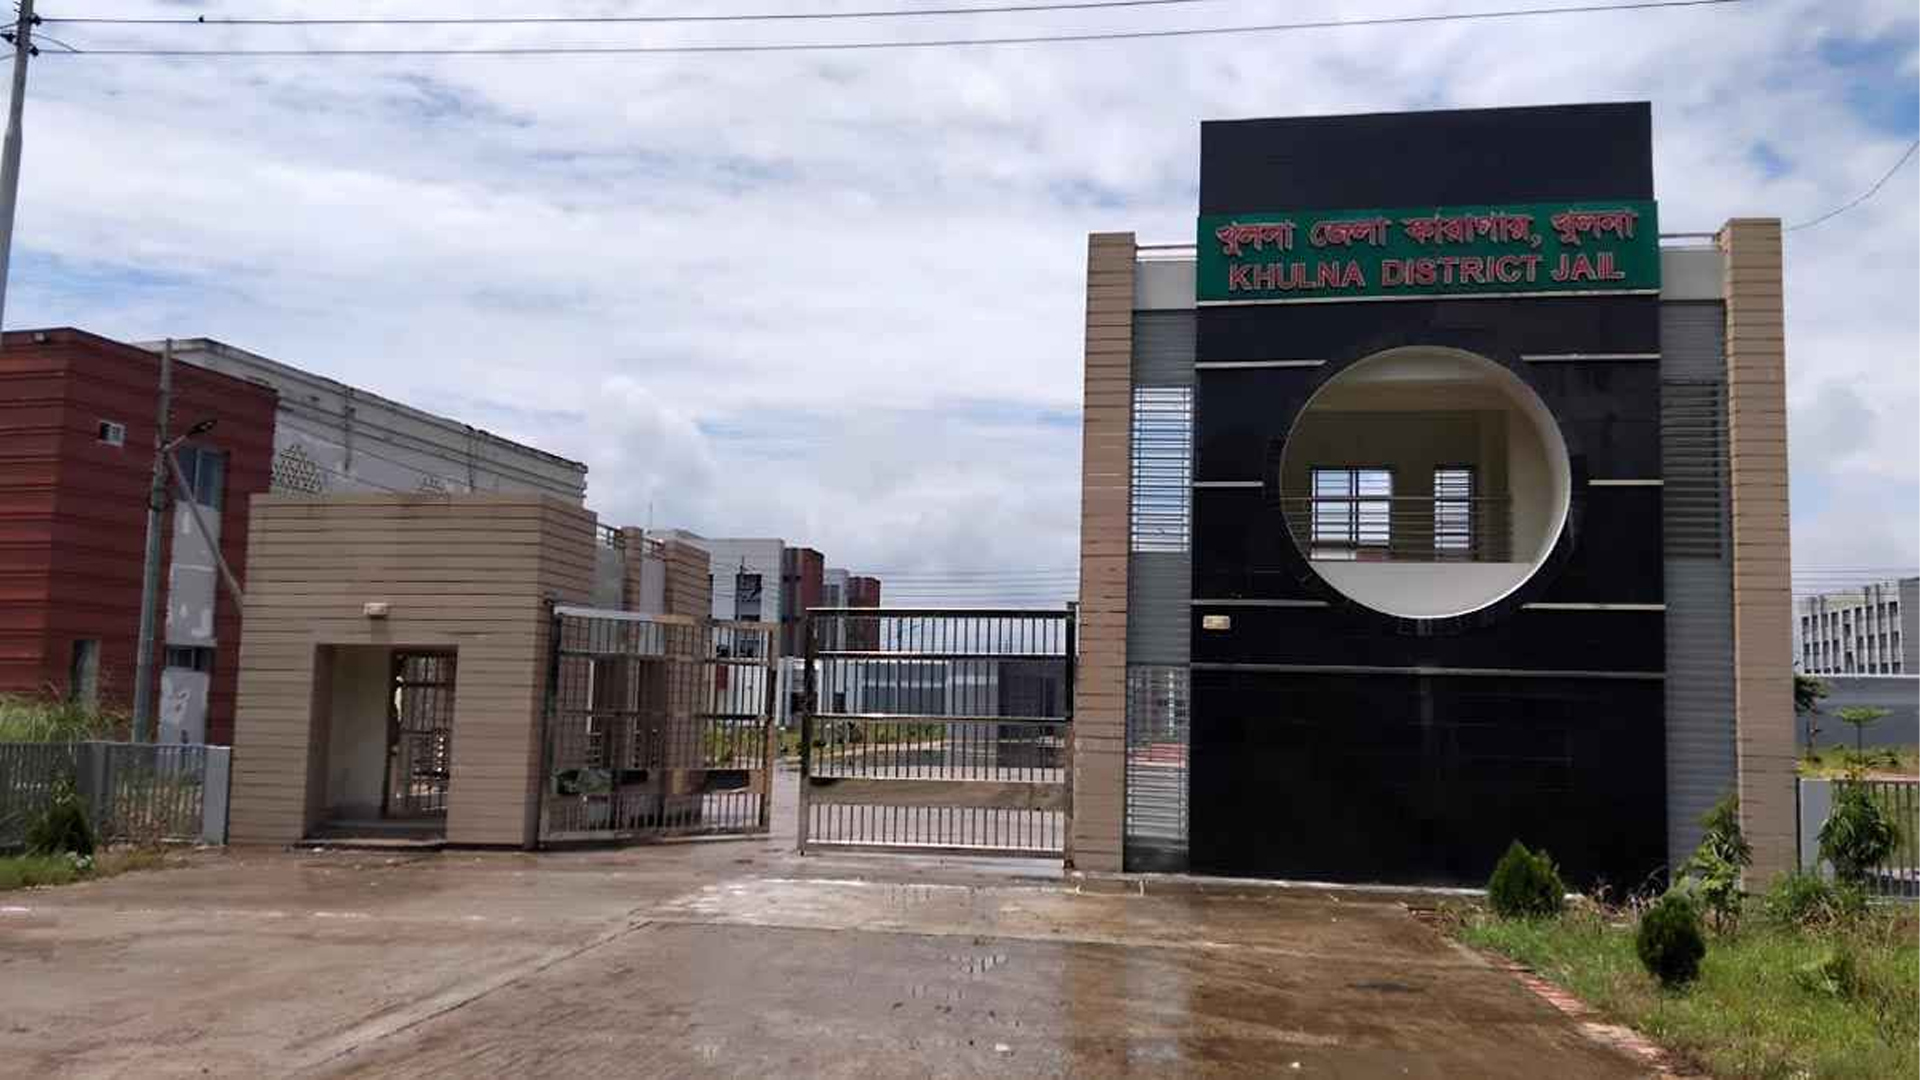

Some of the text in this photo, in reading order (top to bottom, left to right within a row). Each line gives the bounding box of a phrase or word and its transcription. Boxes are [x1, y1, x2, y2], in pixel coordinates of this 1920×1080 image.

[1216, 219, 1297, 256] খুলনা
[1309, 216, 1392, 247] জেলা
[1550, 209, 1638, 246] খুলনা
[1229, 252, 1625, 290] KHULNA DISTRICT JAIL
